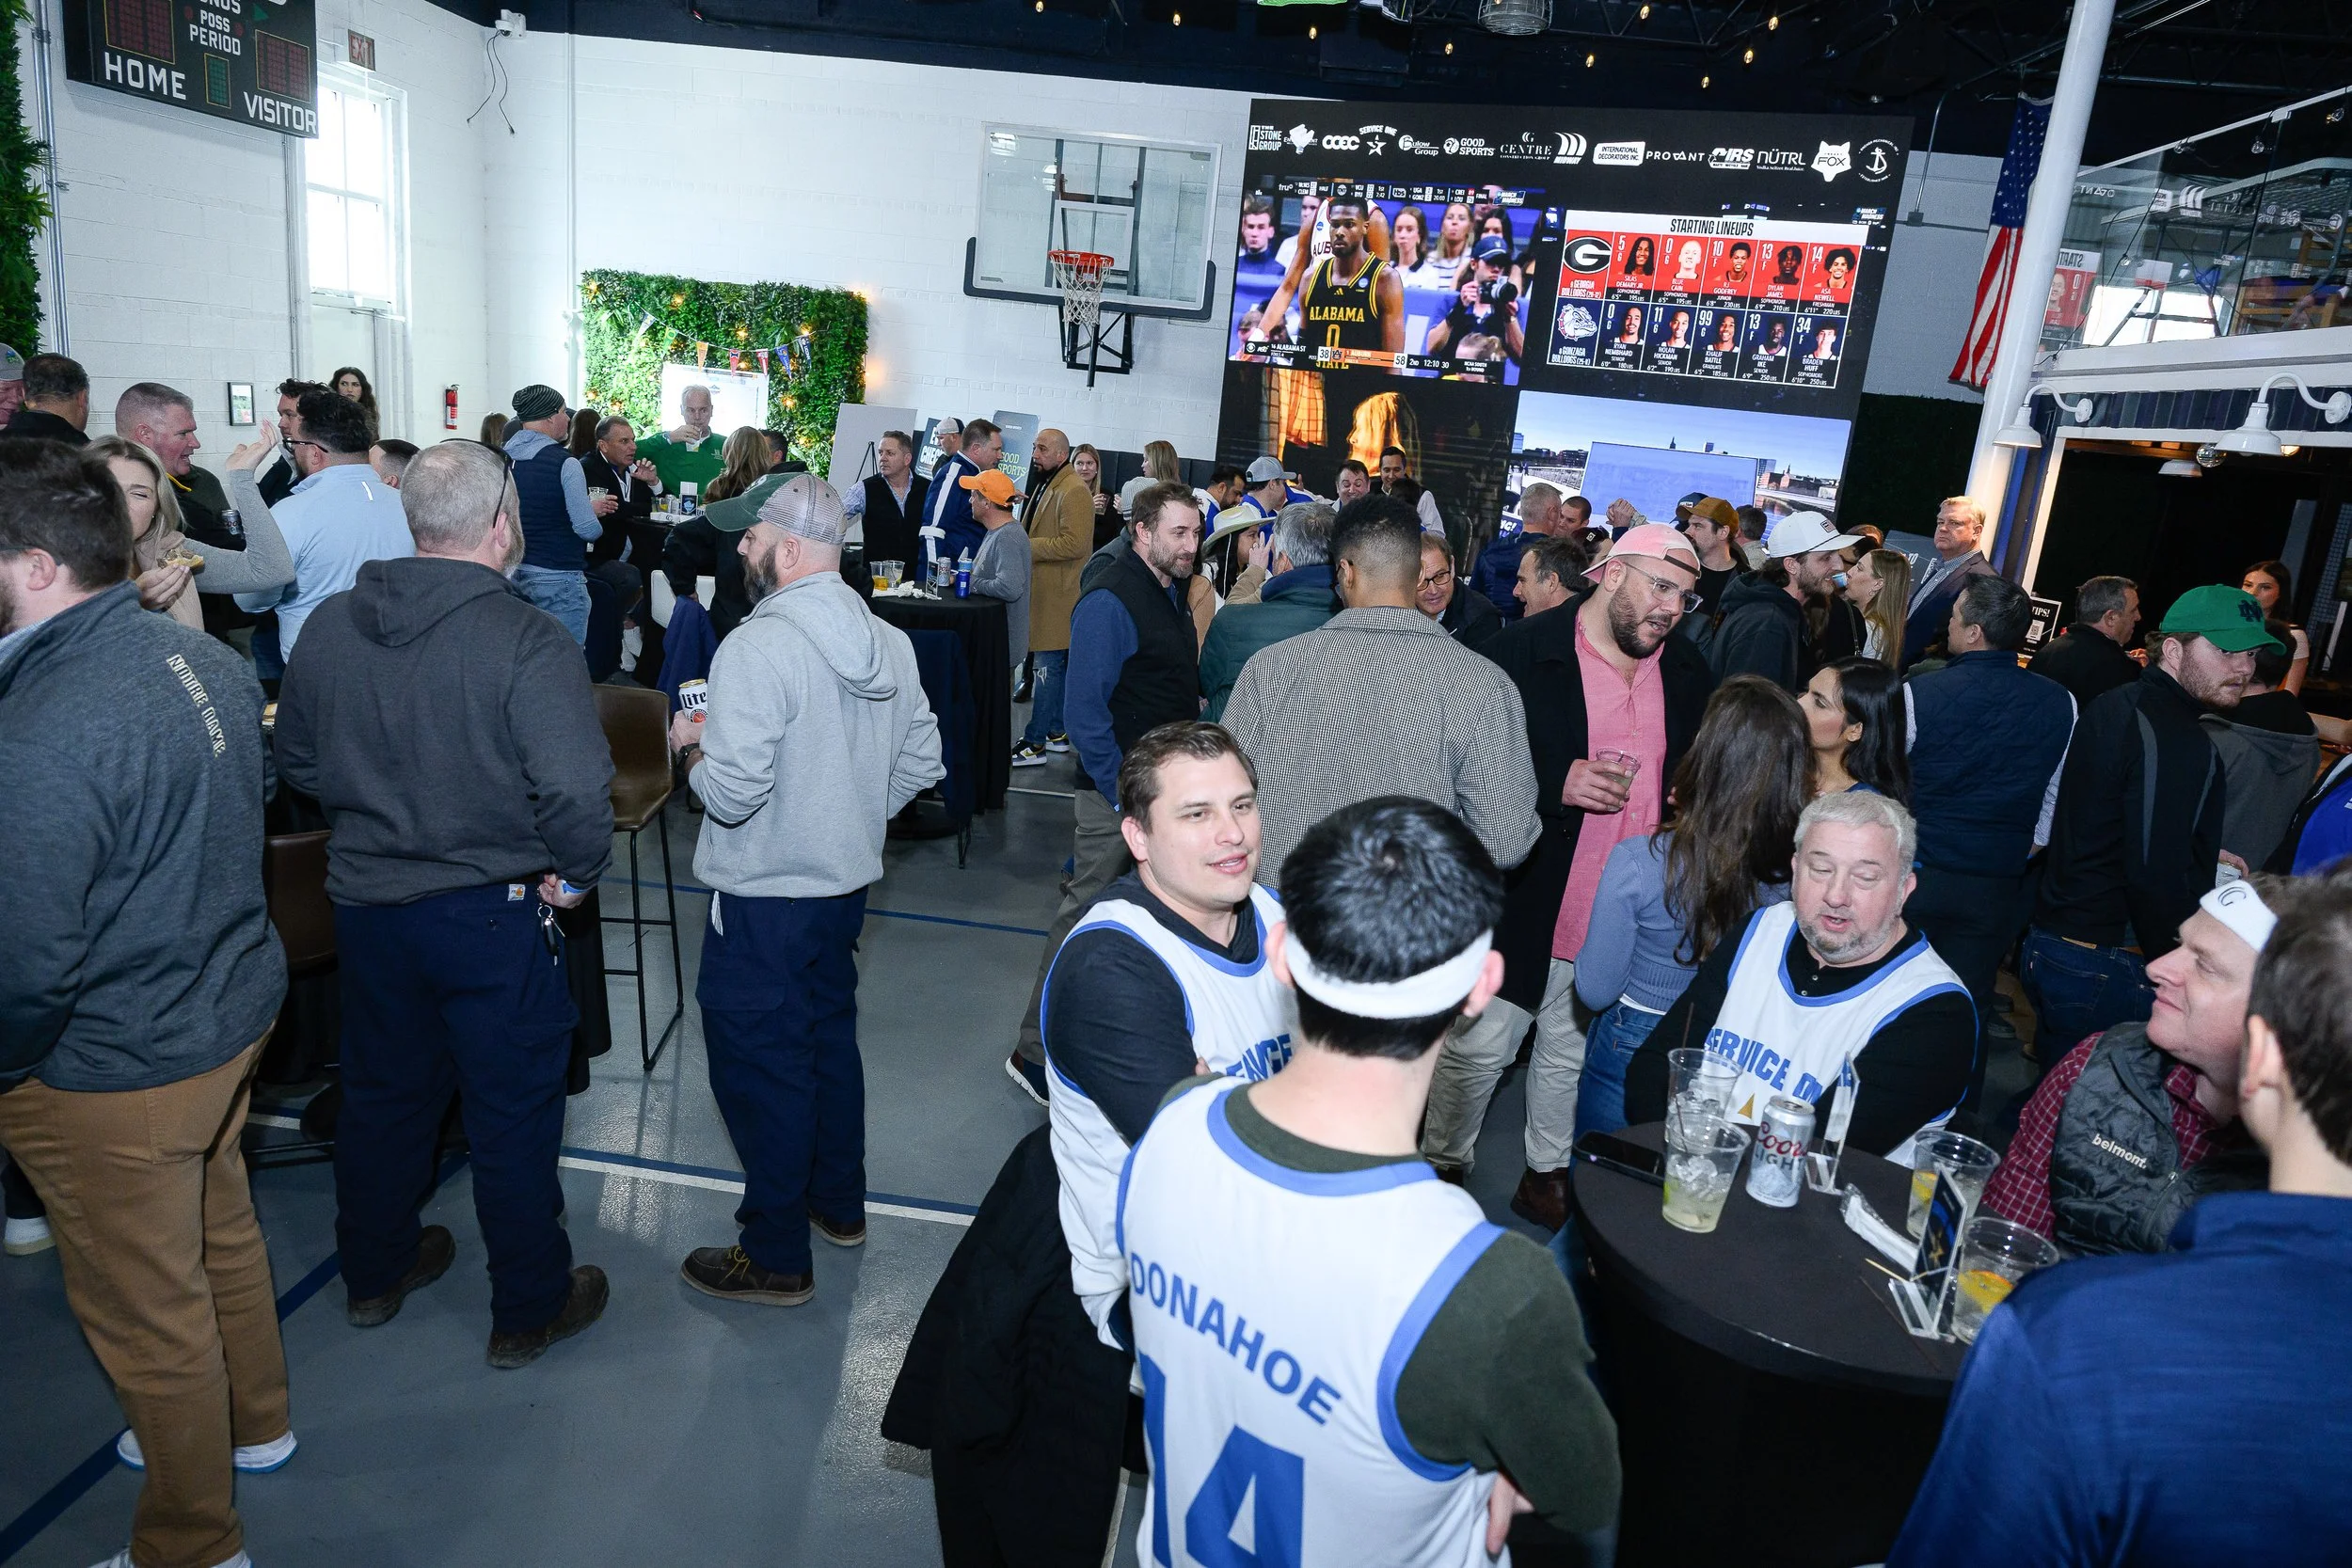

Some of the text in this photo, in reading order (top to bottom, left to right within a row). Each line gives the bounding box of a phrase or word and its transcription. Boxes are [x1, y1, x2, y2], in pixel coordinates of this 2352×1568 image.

[199, 9, 230, 33] POSS
[189, 24, 242, 56] PERIOD
[350, 34, 374, 69] EXIT
[104, 51, 187, 101] HOME
[243, 91, 317, 135] VISITOR
[1260, 130, 1282, 140] STONE
[1359, 125, 1398, 137] SERVICE ONE
[1258, 140, 1282, 151] GROUP
[1460, 137, 1486, 147] GOOD
[1414, 148, 1439, 157] Group
[1459, 147, 1496, 157] SPORTS
[1500, 143, 1552, 156] CENTRE
[1601, 146, 1639, 154] INTERNATIONAL
[1645, 150, 1706, 163] PROVANT
[1818, 156, 1847, 167] FOX
[1670, 218, 1754, 236] STARTING LINEUPS
[1617, 235, 1626, 251] 5
[1665, 237, 1674, 254] 0
[1712, 240, 1724, 257] 10
[1761, 243, 1773, 260] 13
[1811, 245, 1823, 262] 14
[1617, 253, 1623, 262] G
[1664, 255, 1670, 265] G
[1712, 258, 1718, 268] F
[1761, 261, 1767, 271] F
[1812, 263, 1818, 274] F
[1574, 279, 1596, 290] GEORGIA
[1561, 287, 1586, 298] BULLDOGS
[1713, 287, 1738, 295] GODFREY
[1765, 291, 1784, 299] JAMES
[1814, 293, 1836, 302] NEWELL
[1309, 306, 1365, 323] ALABAMA
[1607, 303, 1615, 319] 0
[1654, 307, 1663, 323] 11
[1698, 309, 1713, 327] 99
[1749, 313, 1761, 330] 13
[1606, 320, 1612, 330] G
[1653, 324, 1659, 334] G
[1796, 316, 1812, 334] 34
[1326, 324, 1341, 348] 0
[1700, 326, 1706, 338] G
[1749, 331, 1755, 341] F
[1798, 334, 1804, 345] F
[1319, 349, 1329, 358] 38
[1562, 346, 1586, 356] GONZAGA
[1604, 349, 1633, 357] NEMBHARD
[1395, 356, 1406, 366] 58
[1551, 354, 1577, 364] BULLDOGS
[1653, 353, 1678, 361] HICKMAN
[1704, 356, 1723, 364] BATTLE
[1752, 354, 1775, 362] GRAHAM
[1802, 357, 1823, 366] BRADEN
[1423, 359, 1440, 368] 12:10
[1804, 364, 1819, 372] HUFF
[1797, 371, 1823, 379] SOPHOMORE
[997, 464, 1028, 477] SPORTS
[2032, 606, 2051, 618] TIPS!
[681, 691, 707, 709] Lite
[166, 654, 227, 758] NOTRE DAME
[1755, 1148, 1805, 1171] LIGHT
[1130, 1252, 1343, 1427] DONAHOE
[1137, 1349, 1305, 1568] 14
